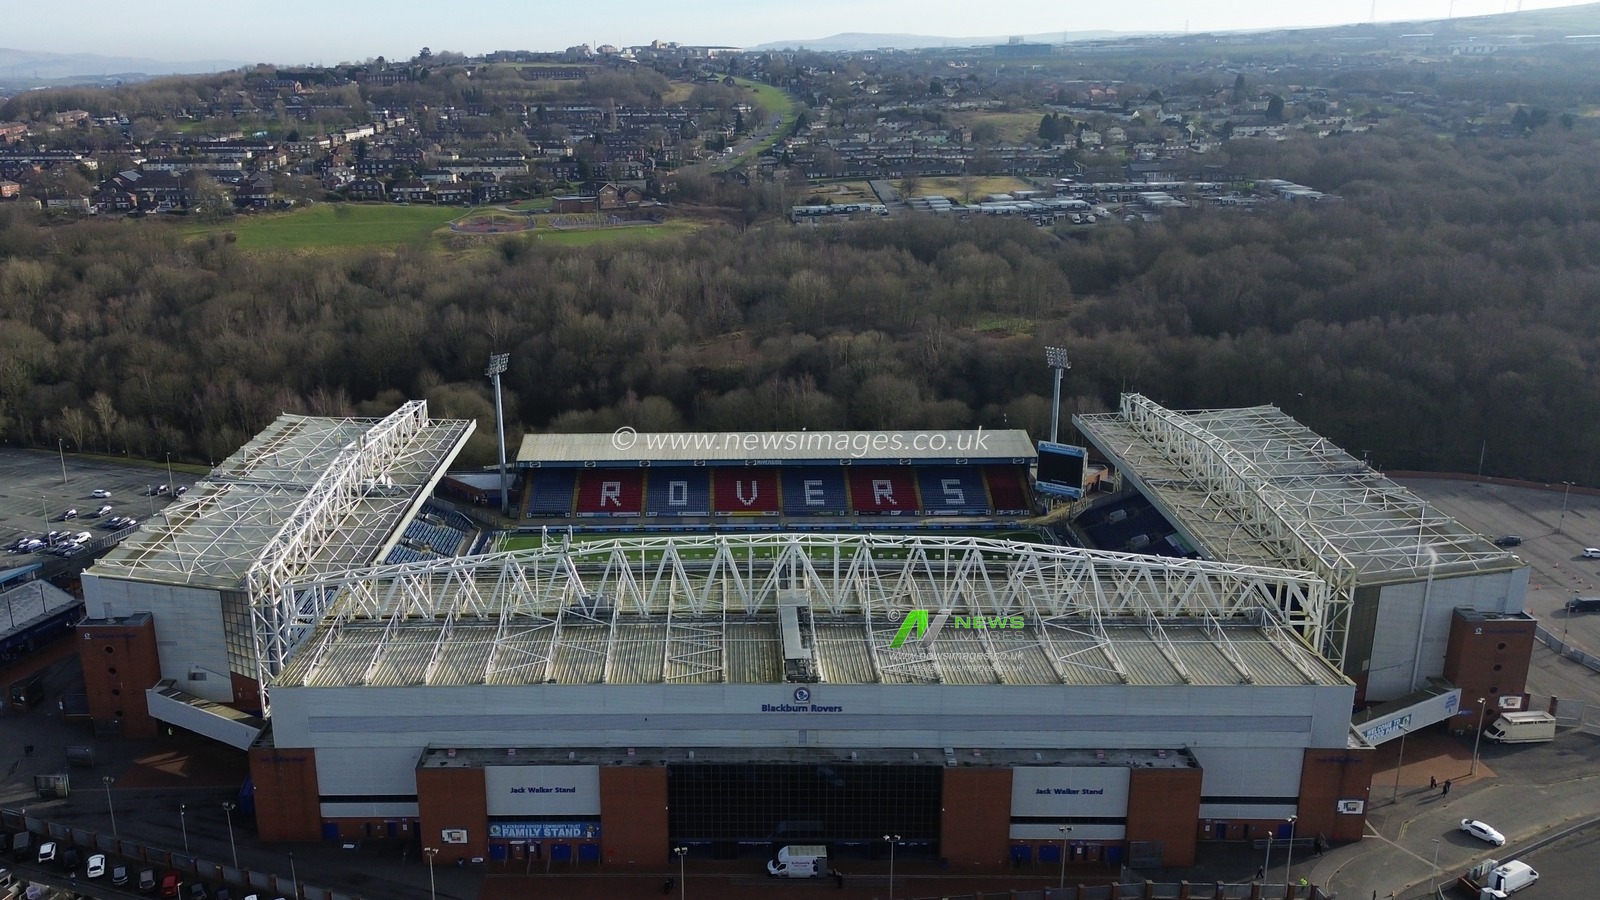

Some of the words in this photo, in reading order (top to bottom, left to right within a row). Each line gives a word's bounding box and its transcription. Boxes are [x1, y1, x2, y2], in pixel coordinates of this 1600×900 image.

[761, 704, 808, 712] Blackburn
[811, 704, 843, 713] Rovers
[1367, 722, 1392, 735] WELCOME
[510, 786, 525, 794] Jack
[528, 786, 553, 794] Walker
[502, 828, 541, 837] FAMILY
[543, 828, 581, 837] STAND
